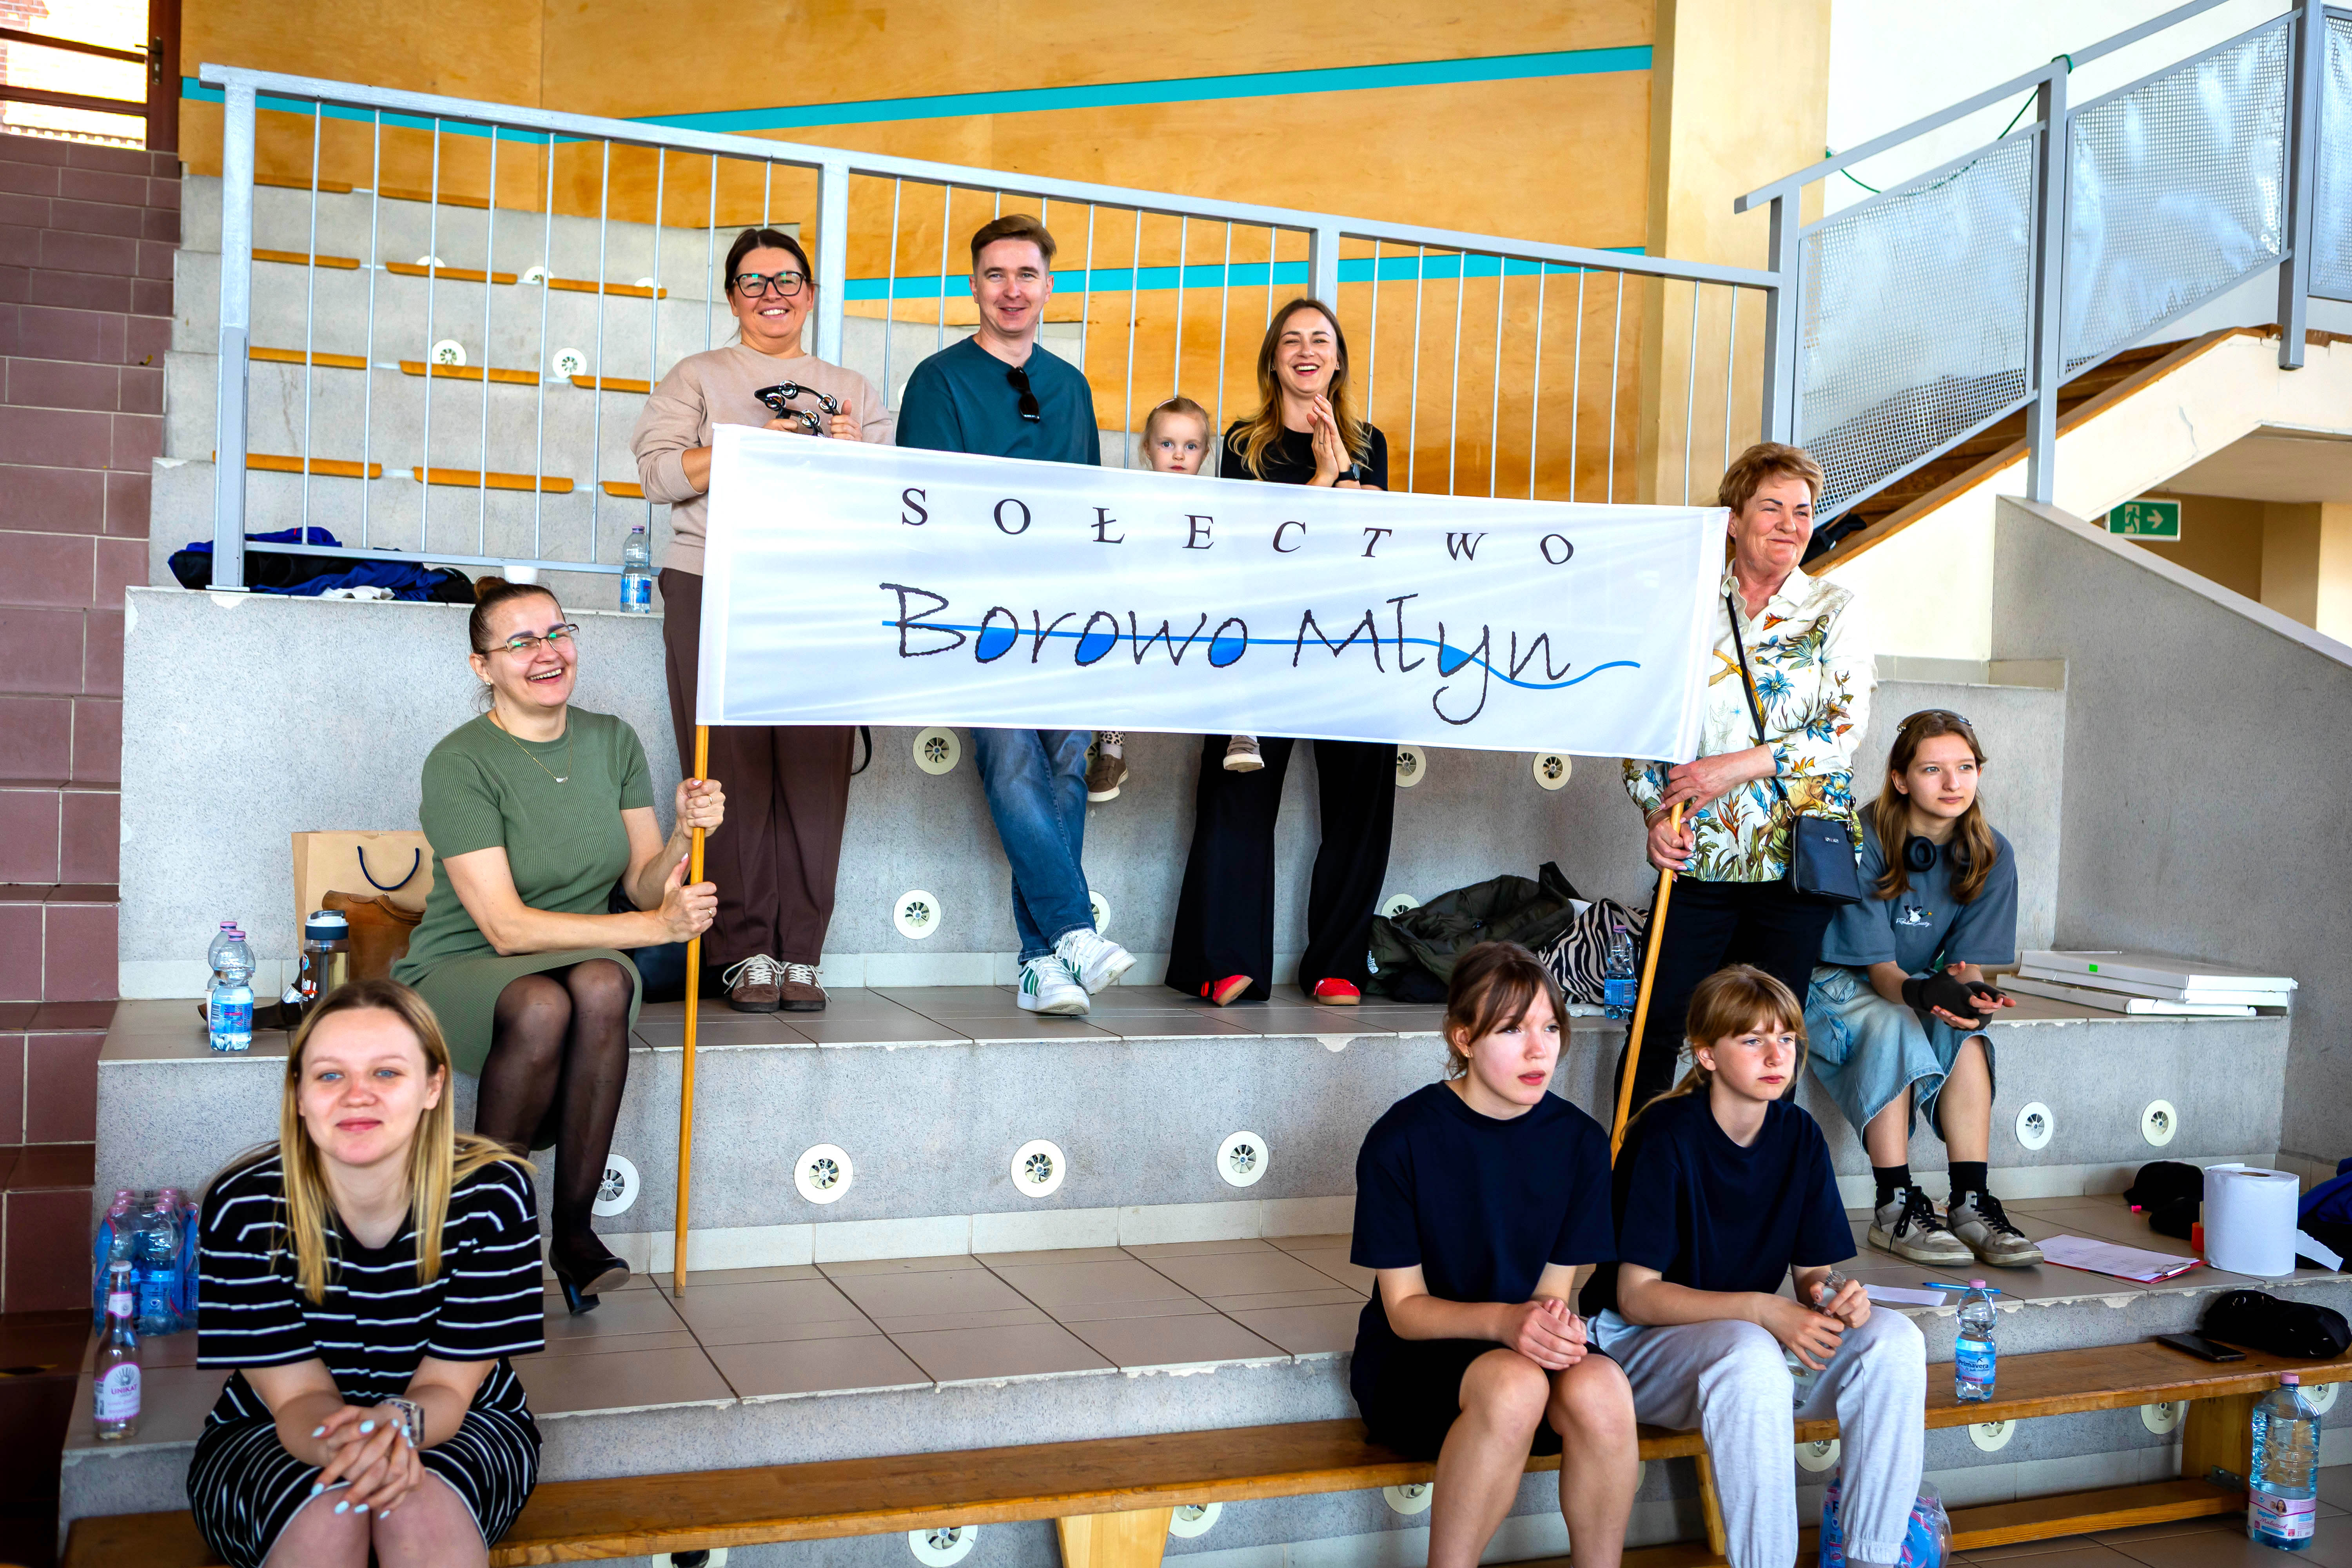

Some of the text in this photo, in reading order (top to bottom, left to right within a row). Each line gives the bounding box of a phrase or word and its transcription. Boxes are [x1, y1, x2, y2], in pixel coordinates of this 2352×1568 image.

[902, 488, 1574, 565] SOŁECTWO
[879, 583, 1571, 725] Borowo Młyn
[1958, 1359, 1989, 1368] Primavera
[111, 1383, 138, 1395] UNIKAT
[2257, 1508, 2277, 1520] Saguaro
